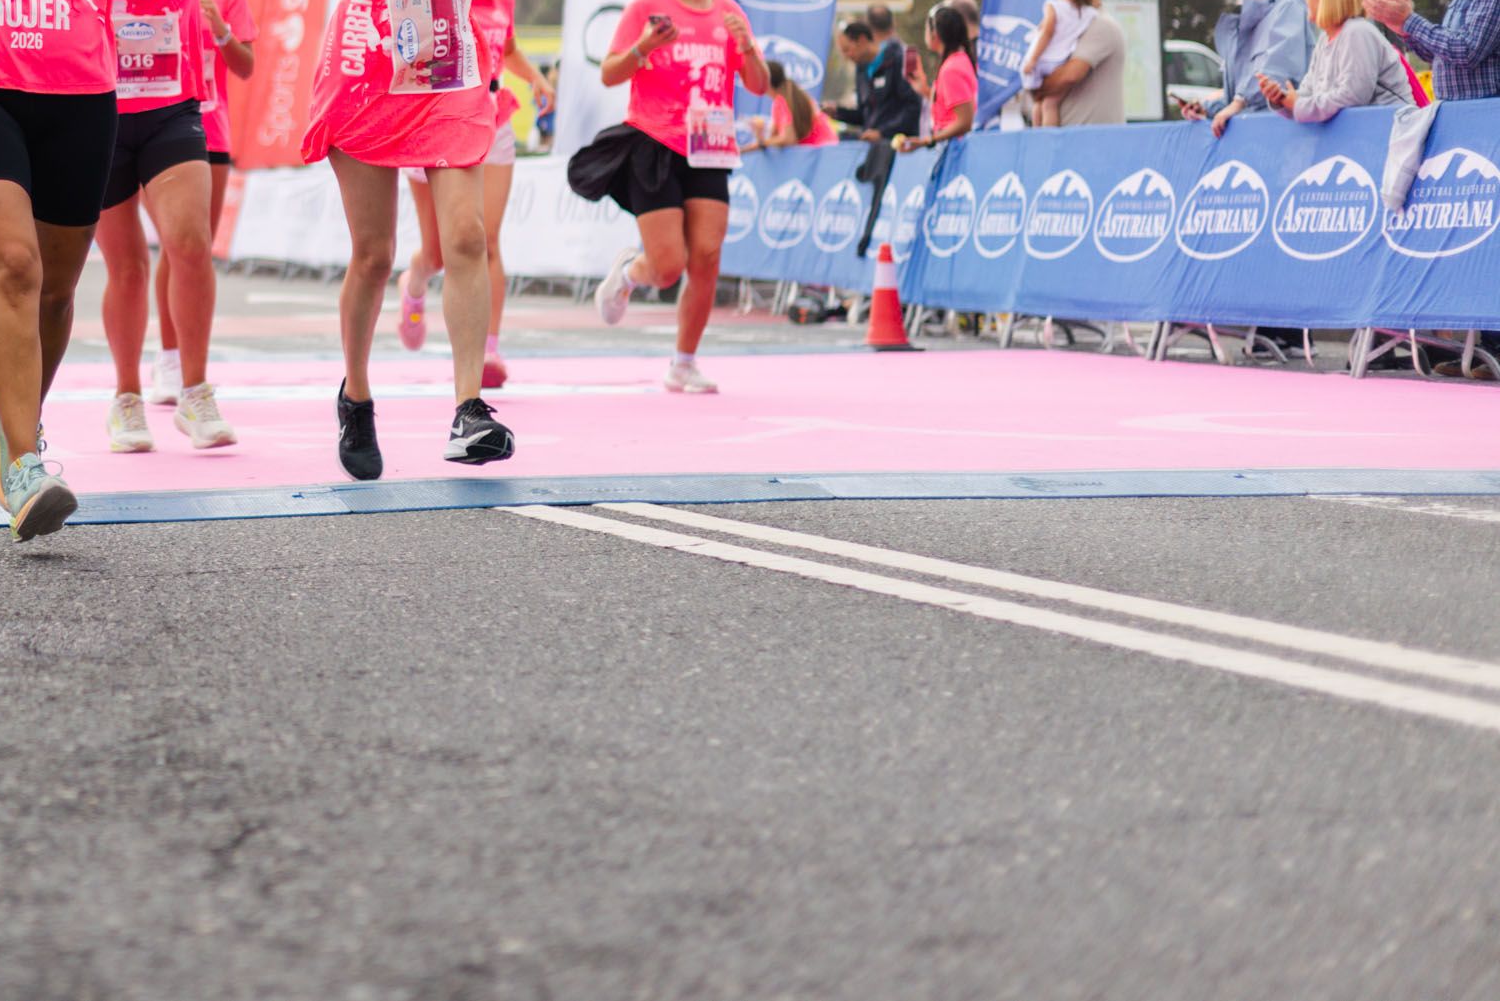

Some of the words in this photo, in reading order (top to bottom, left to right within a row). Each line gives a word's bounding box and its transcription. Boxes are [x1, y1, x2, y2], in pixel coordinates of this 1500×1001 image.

[10, 32, 43, 49] 2026
[406, 20, 414, 60] ASTURIANA
[434, 18, 448, 57] 016
[120, 55, 155, 69] 016
[259, 52, 300, 147] Sports
[1300, 192, 1332, 203] CENTRAL
[1334, 190, 1369, 201] LECHERA
[1412, 185, 1453, 198] CENTRAL
[1098, 203, 1168, 238] ASTURIANA
[1180, 200, 1259, 236] ASTURIANA
[1278, 195, 1366, 233] ASTURIANA
